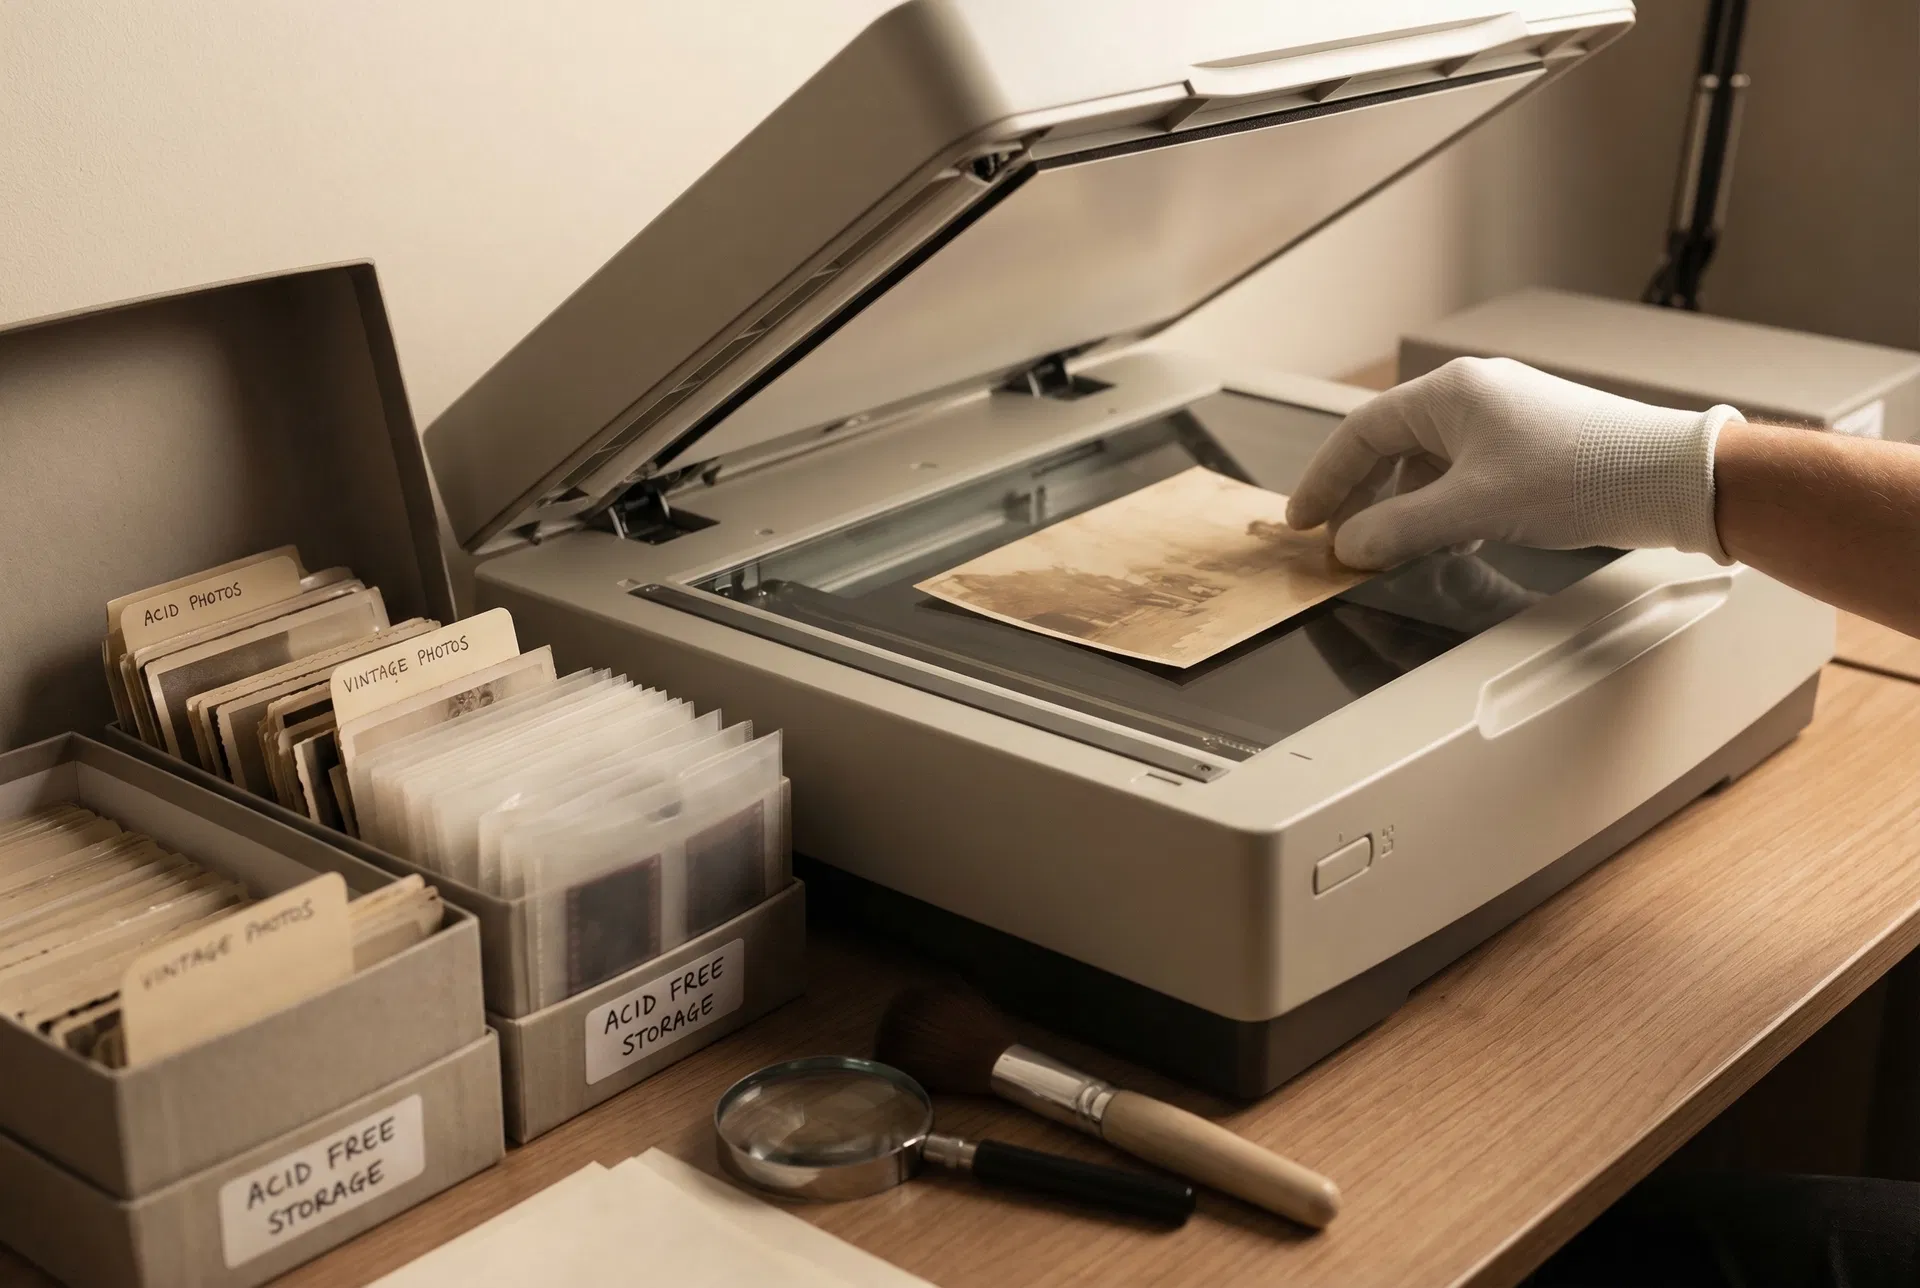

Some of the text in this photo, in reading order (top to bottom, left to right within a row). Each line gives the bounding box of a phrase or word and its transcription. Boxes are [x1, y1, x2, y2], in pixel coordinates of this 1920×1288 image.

[143, 582, 243, 627] ACID PHOTOS
[343, 635, 470, 694] VINTAGE PHOTOS
[604, 956, 724, 1035] ACID FREE
[622, 993, 714, 1056] STORAGE
[247, 1115, 396, 1211] ACID FREE
[267, 1159, 385, 1235] STORAGE
